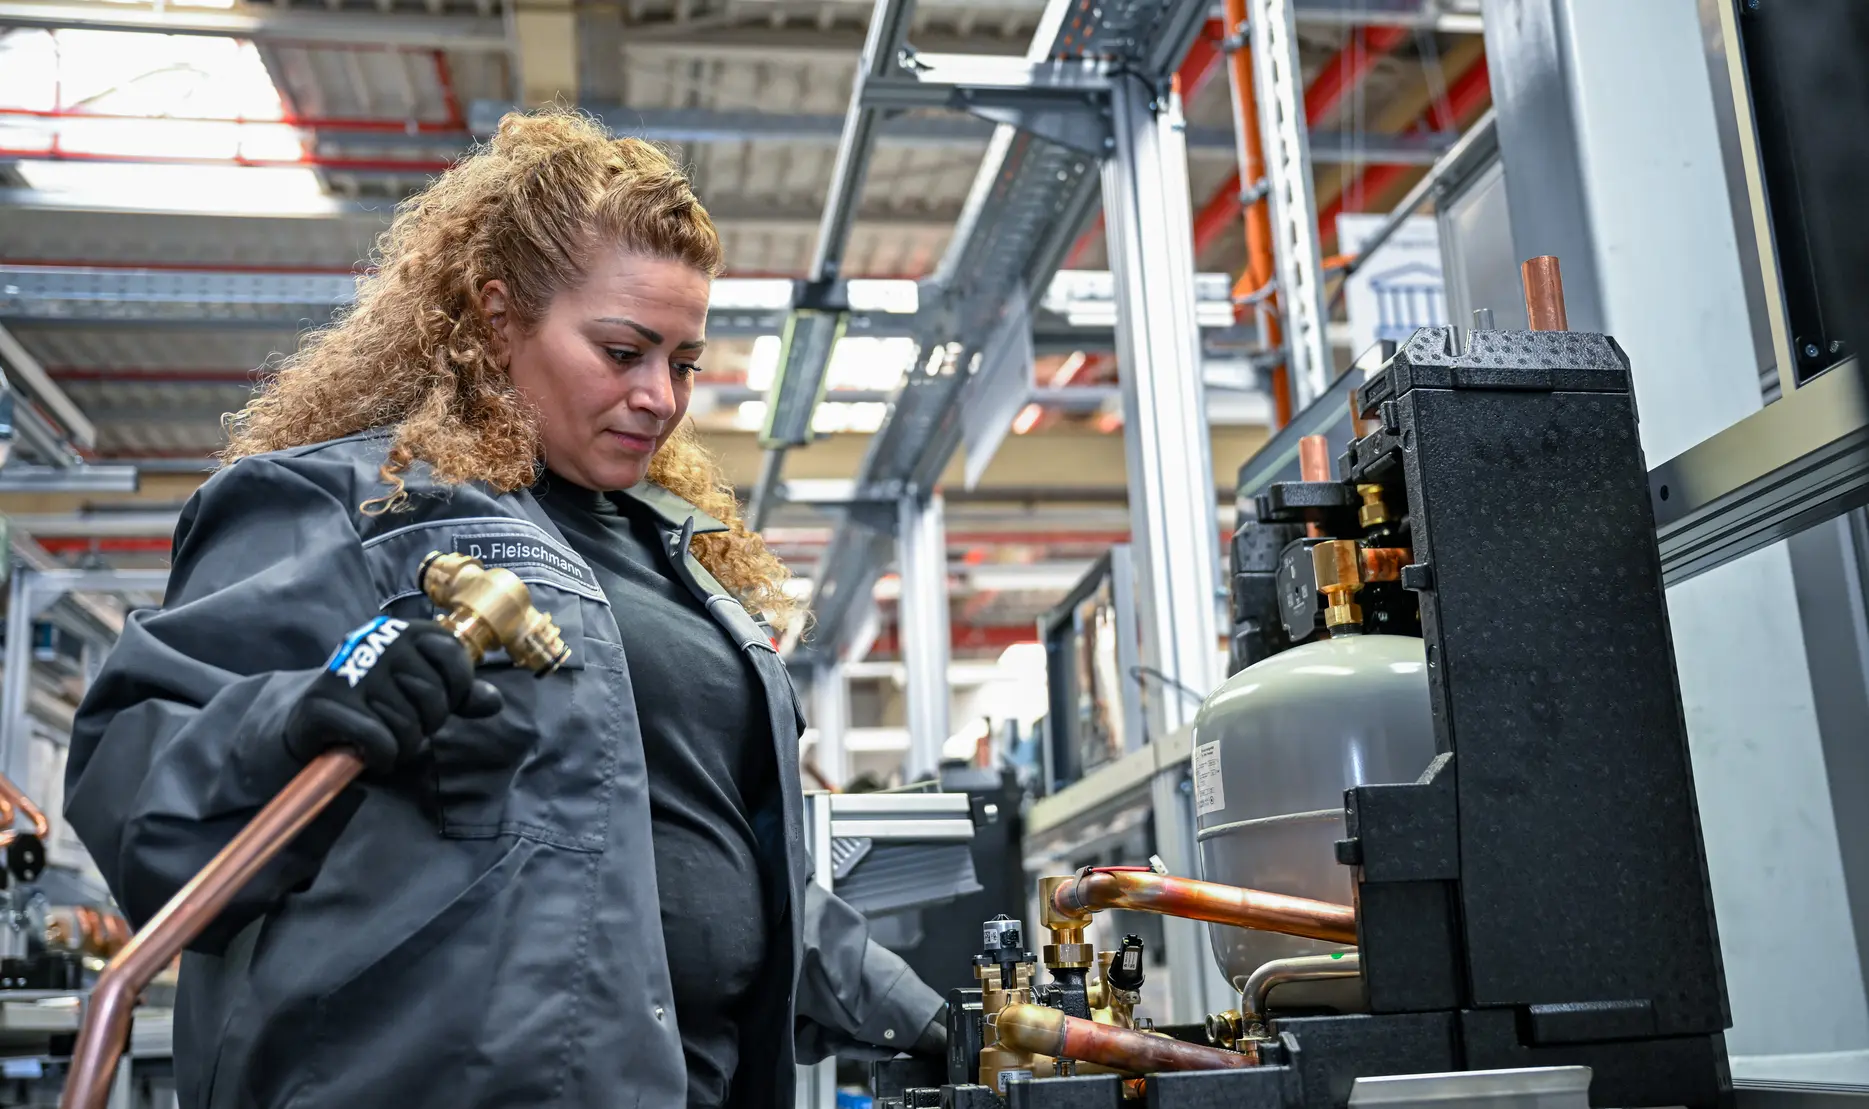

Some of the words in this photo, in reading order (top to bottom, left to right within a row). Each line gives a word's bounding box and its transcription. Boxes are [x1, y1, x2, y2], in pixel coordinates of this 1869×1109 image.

[470, 544, 487, 559] D.
[491, 543, 583, 578] Fleischmann
[336, 618, 410, 688] uvex
